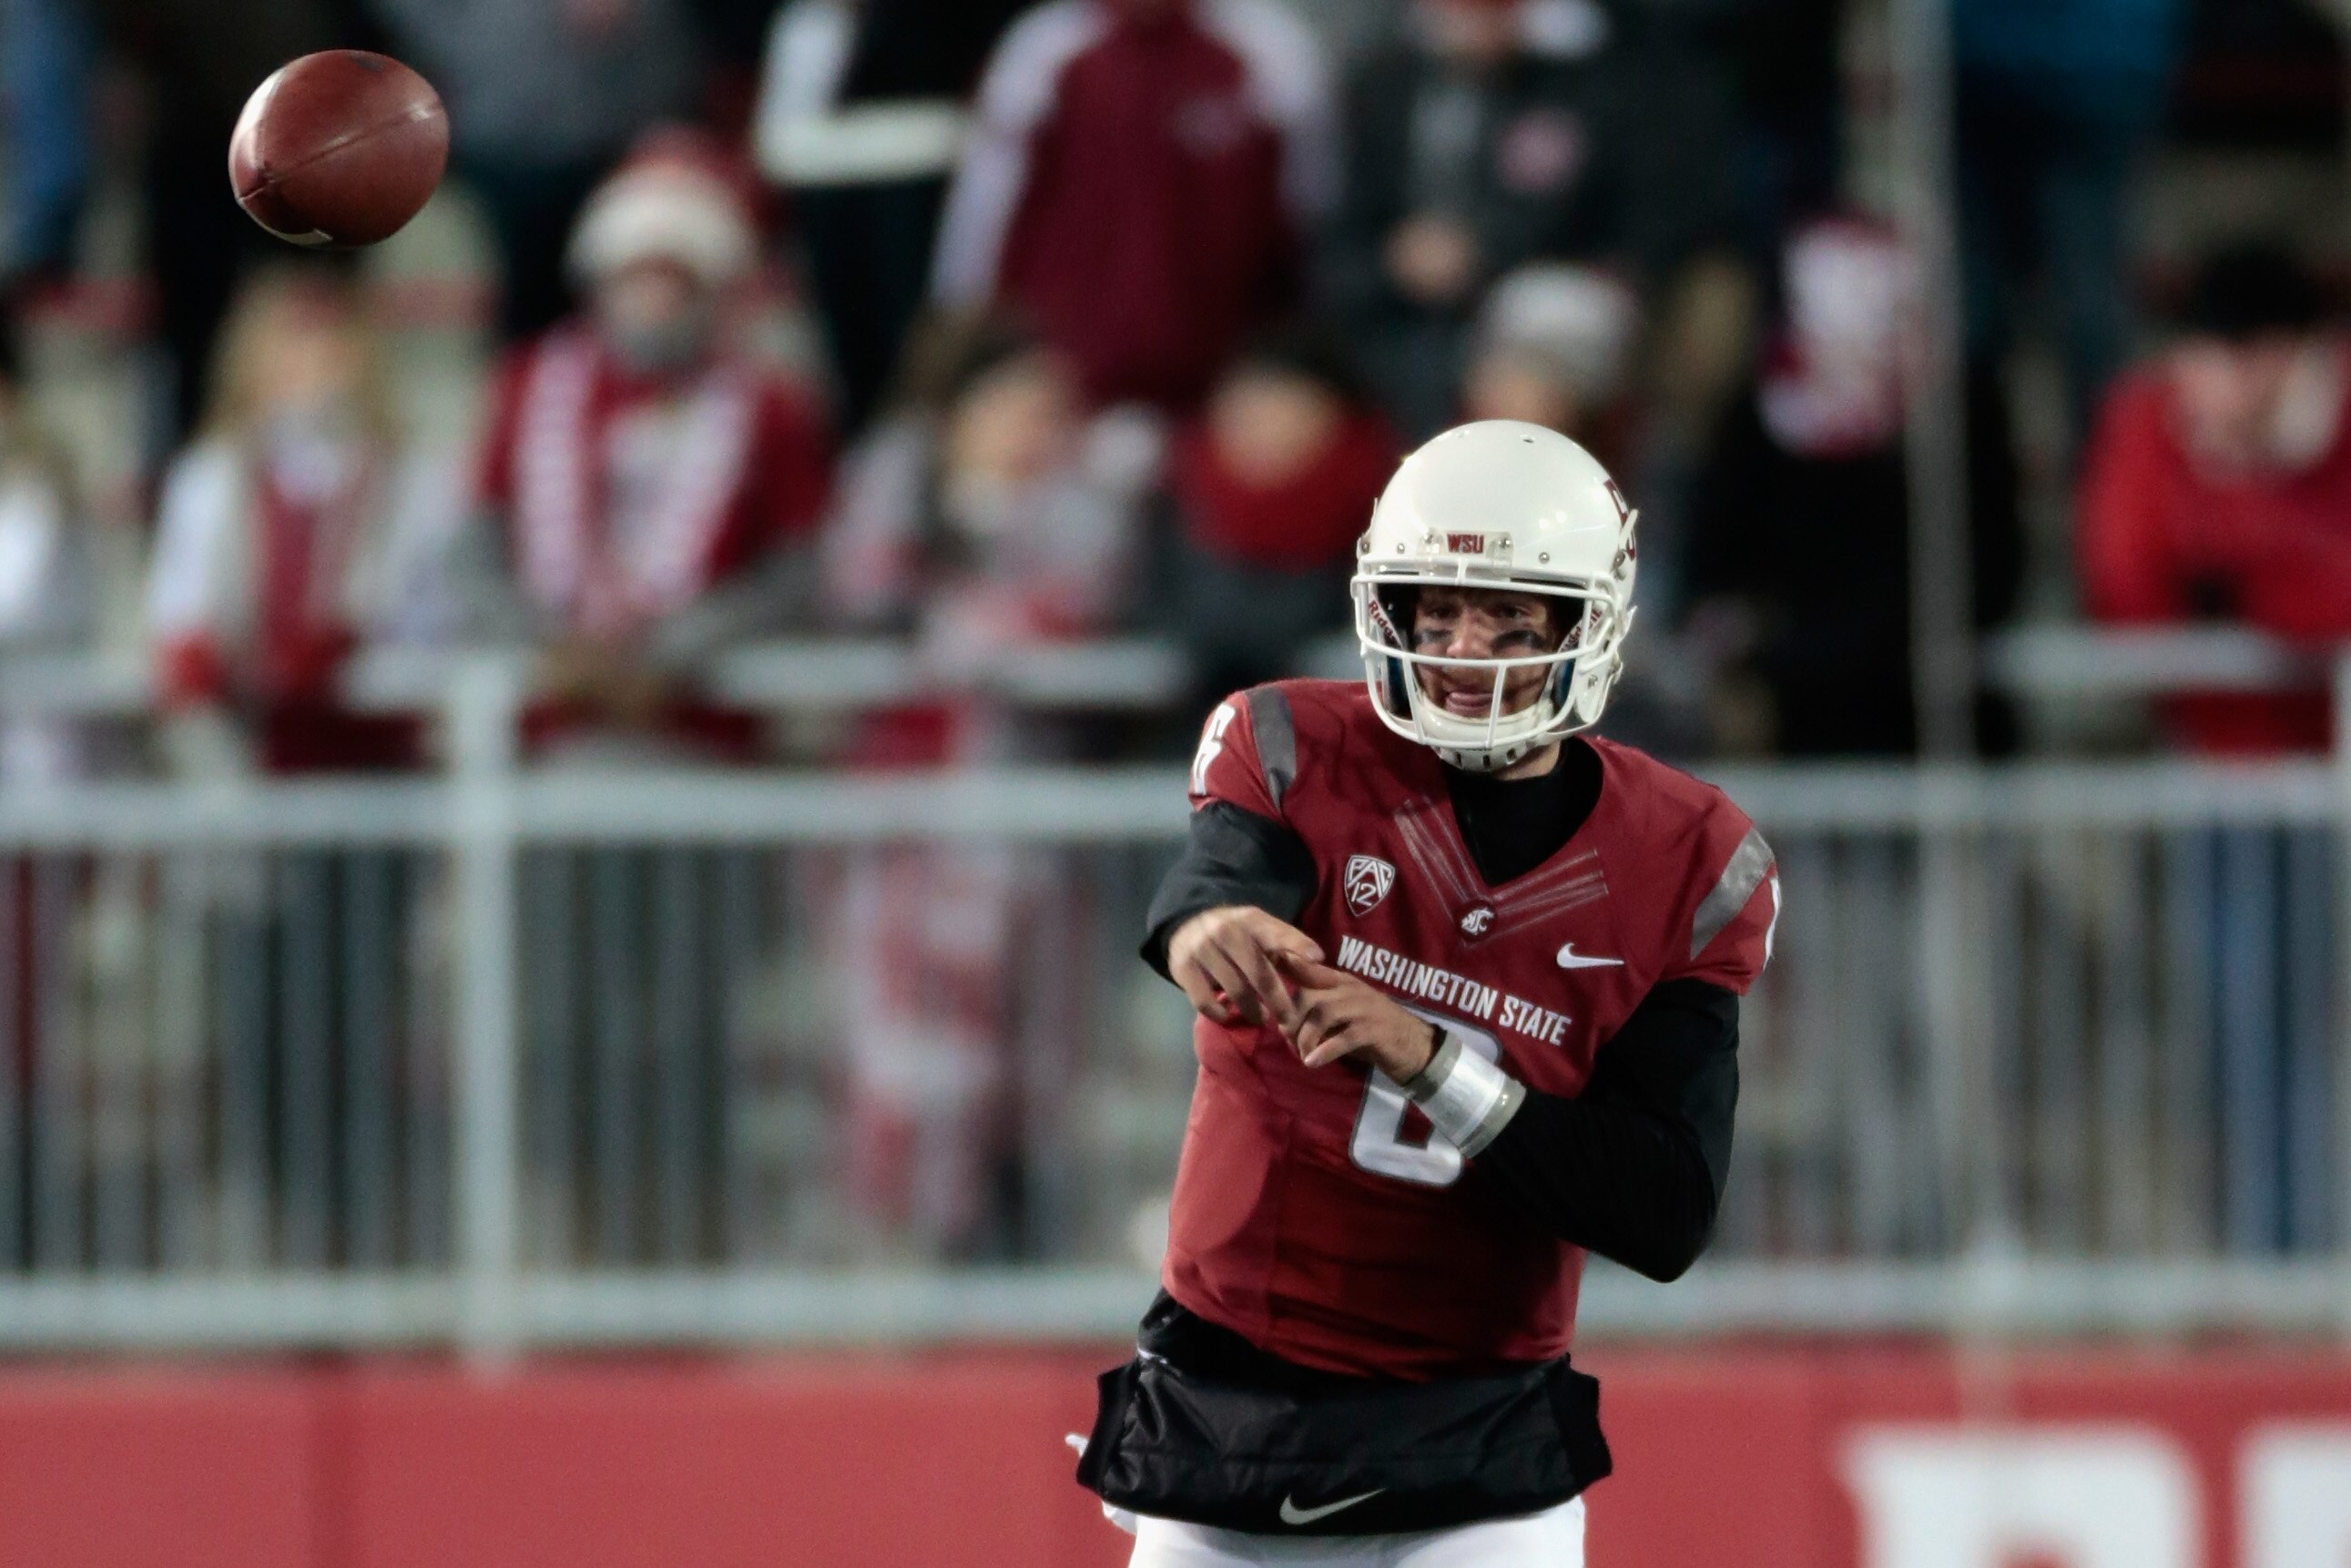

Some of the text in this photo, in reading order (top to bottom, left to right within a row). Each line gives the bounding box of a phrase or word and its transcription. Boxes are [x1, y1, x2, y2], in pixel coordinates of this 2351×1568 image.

[1447, 534, 1484, 554] WSU
[1369, 599, 1401, 648] Ridd
[1348, 859, 1392, 899] PAC
[1351, 881, 1377, 906] 12
[1337, 935, 1572, 1046] WASHINGTON STATE
